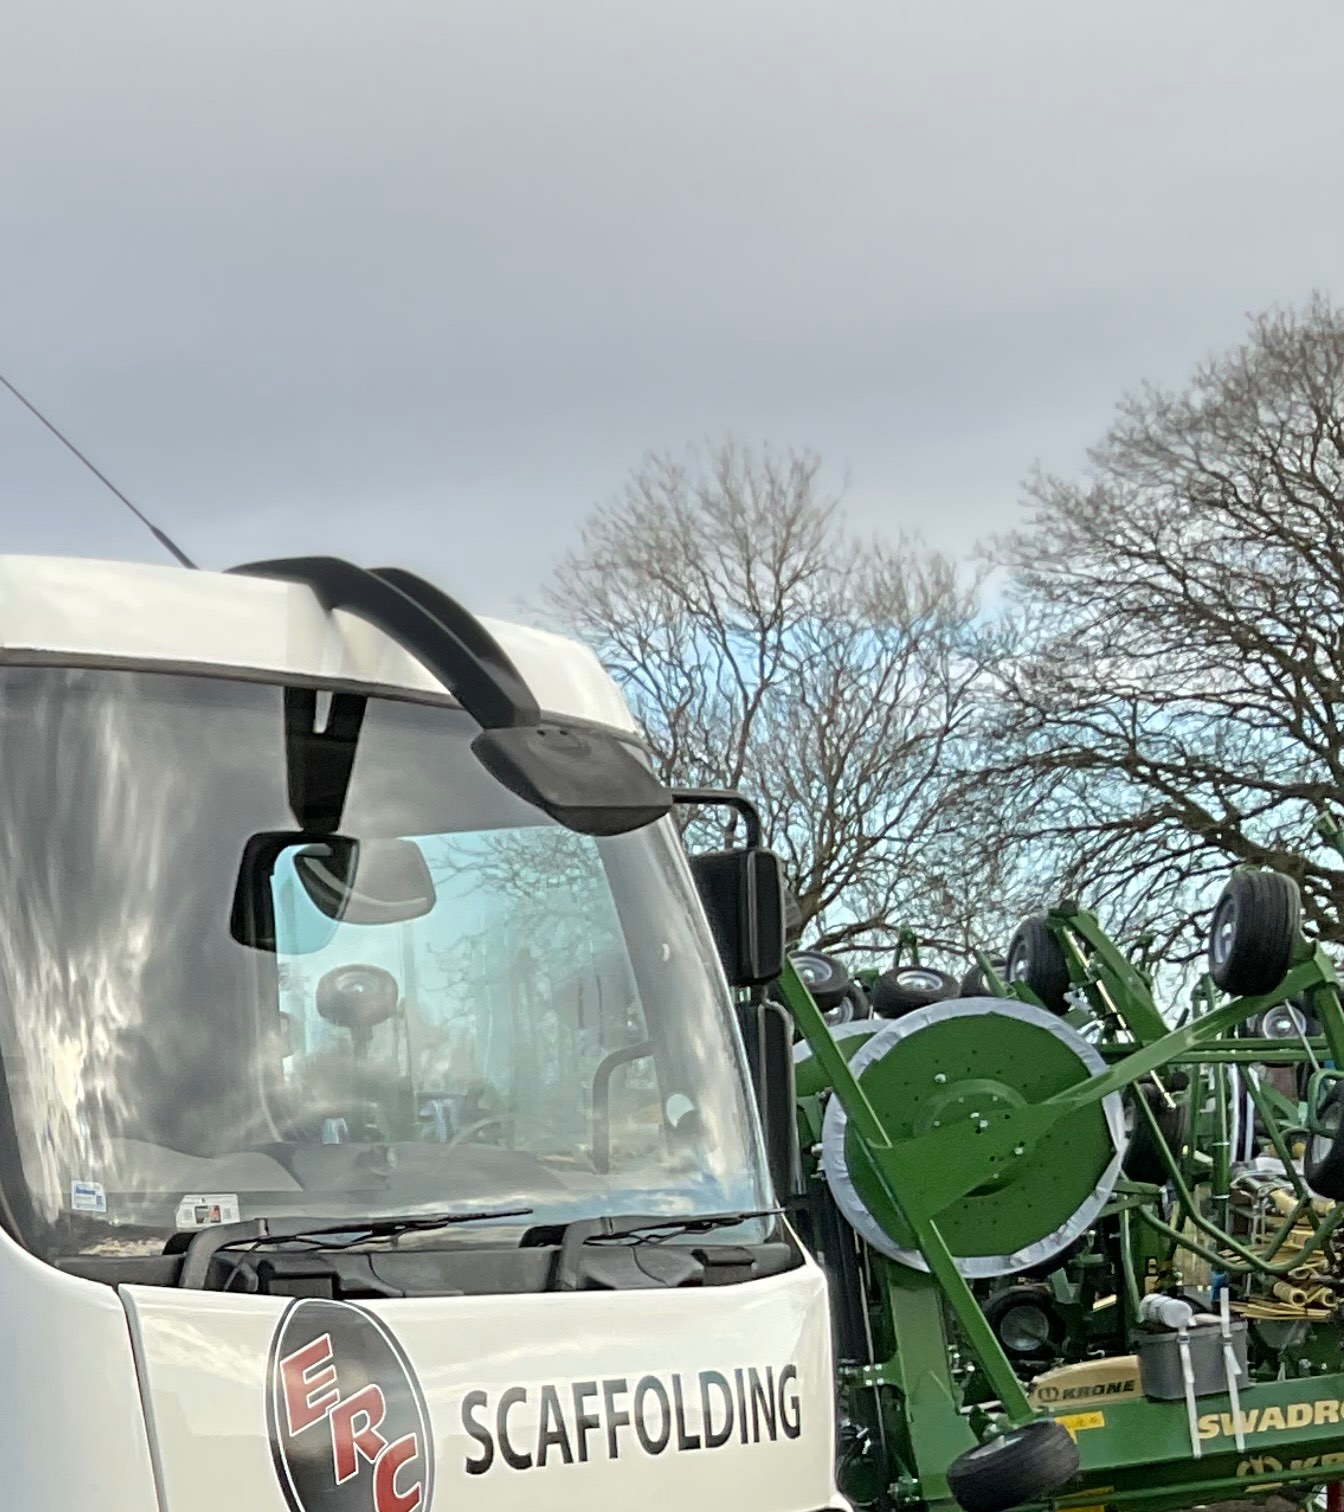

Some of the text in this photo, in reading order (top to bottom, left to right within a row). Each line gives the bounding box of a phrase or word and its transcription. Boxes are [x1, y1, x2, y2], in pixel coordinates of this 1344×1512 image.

[1063, 1379, 1136, 1400] KRONE
[463, 1363, 802, 1477] SCAFFOLDING
[1196, 1399, 1344, 1440] SWADR
